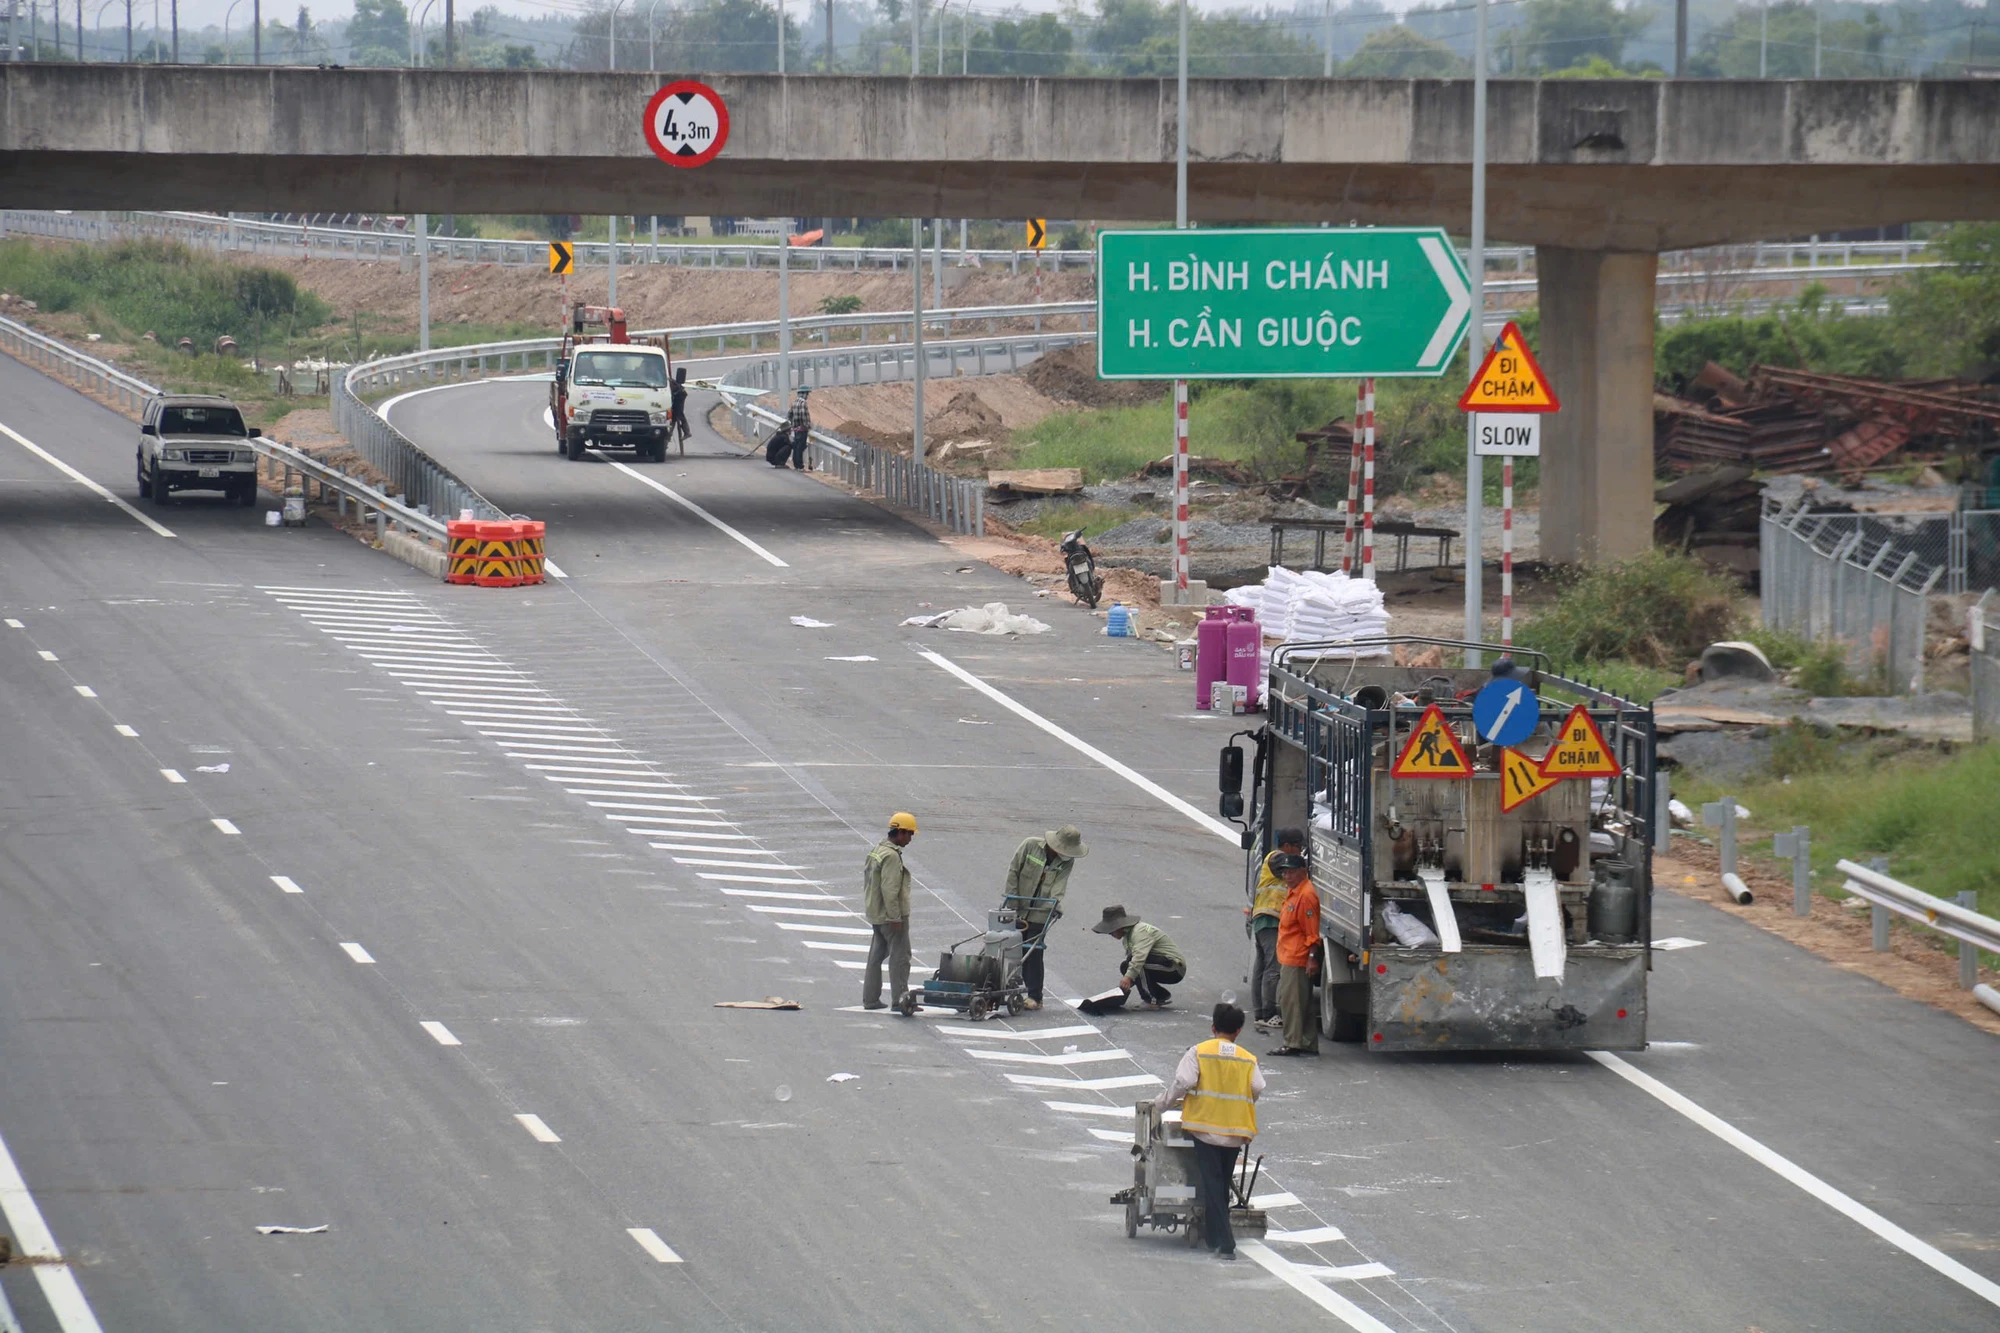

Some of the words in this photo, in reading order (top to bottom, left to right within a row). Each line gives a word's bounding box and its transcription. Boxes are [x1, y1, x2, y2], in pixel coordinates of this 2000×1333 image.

[663, 109, 710, 141] 4,3m
[1128, 261, 1158, 291] H.
[1168, 253, 1249, 291] BÌNH
[1265, 252, 1389, 290] CHÁNH
[1128, 319, 1158, 348] H.
[1168, 306, 1242, 348] CẦN
[1257, 310, 1362, 352] GIUỘC
[1500, 358, 1517, 373] ĐI
[1482, 378, 1534, 400] CHẬM
[1482, 426, 1531, 446] SLOW
[1573, 729, 1586, 741] ĐI
[1559, 748, 1599, 767] CHẬM
